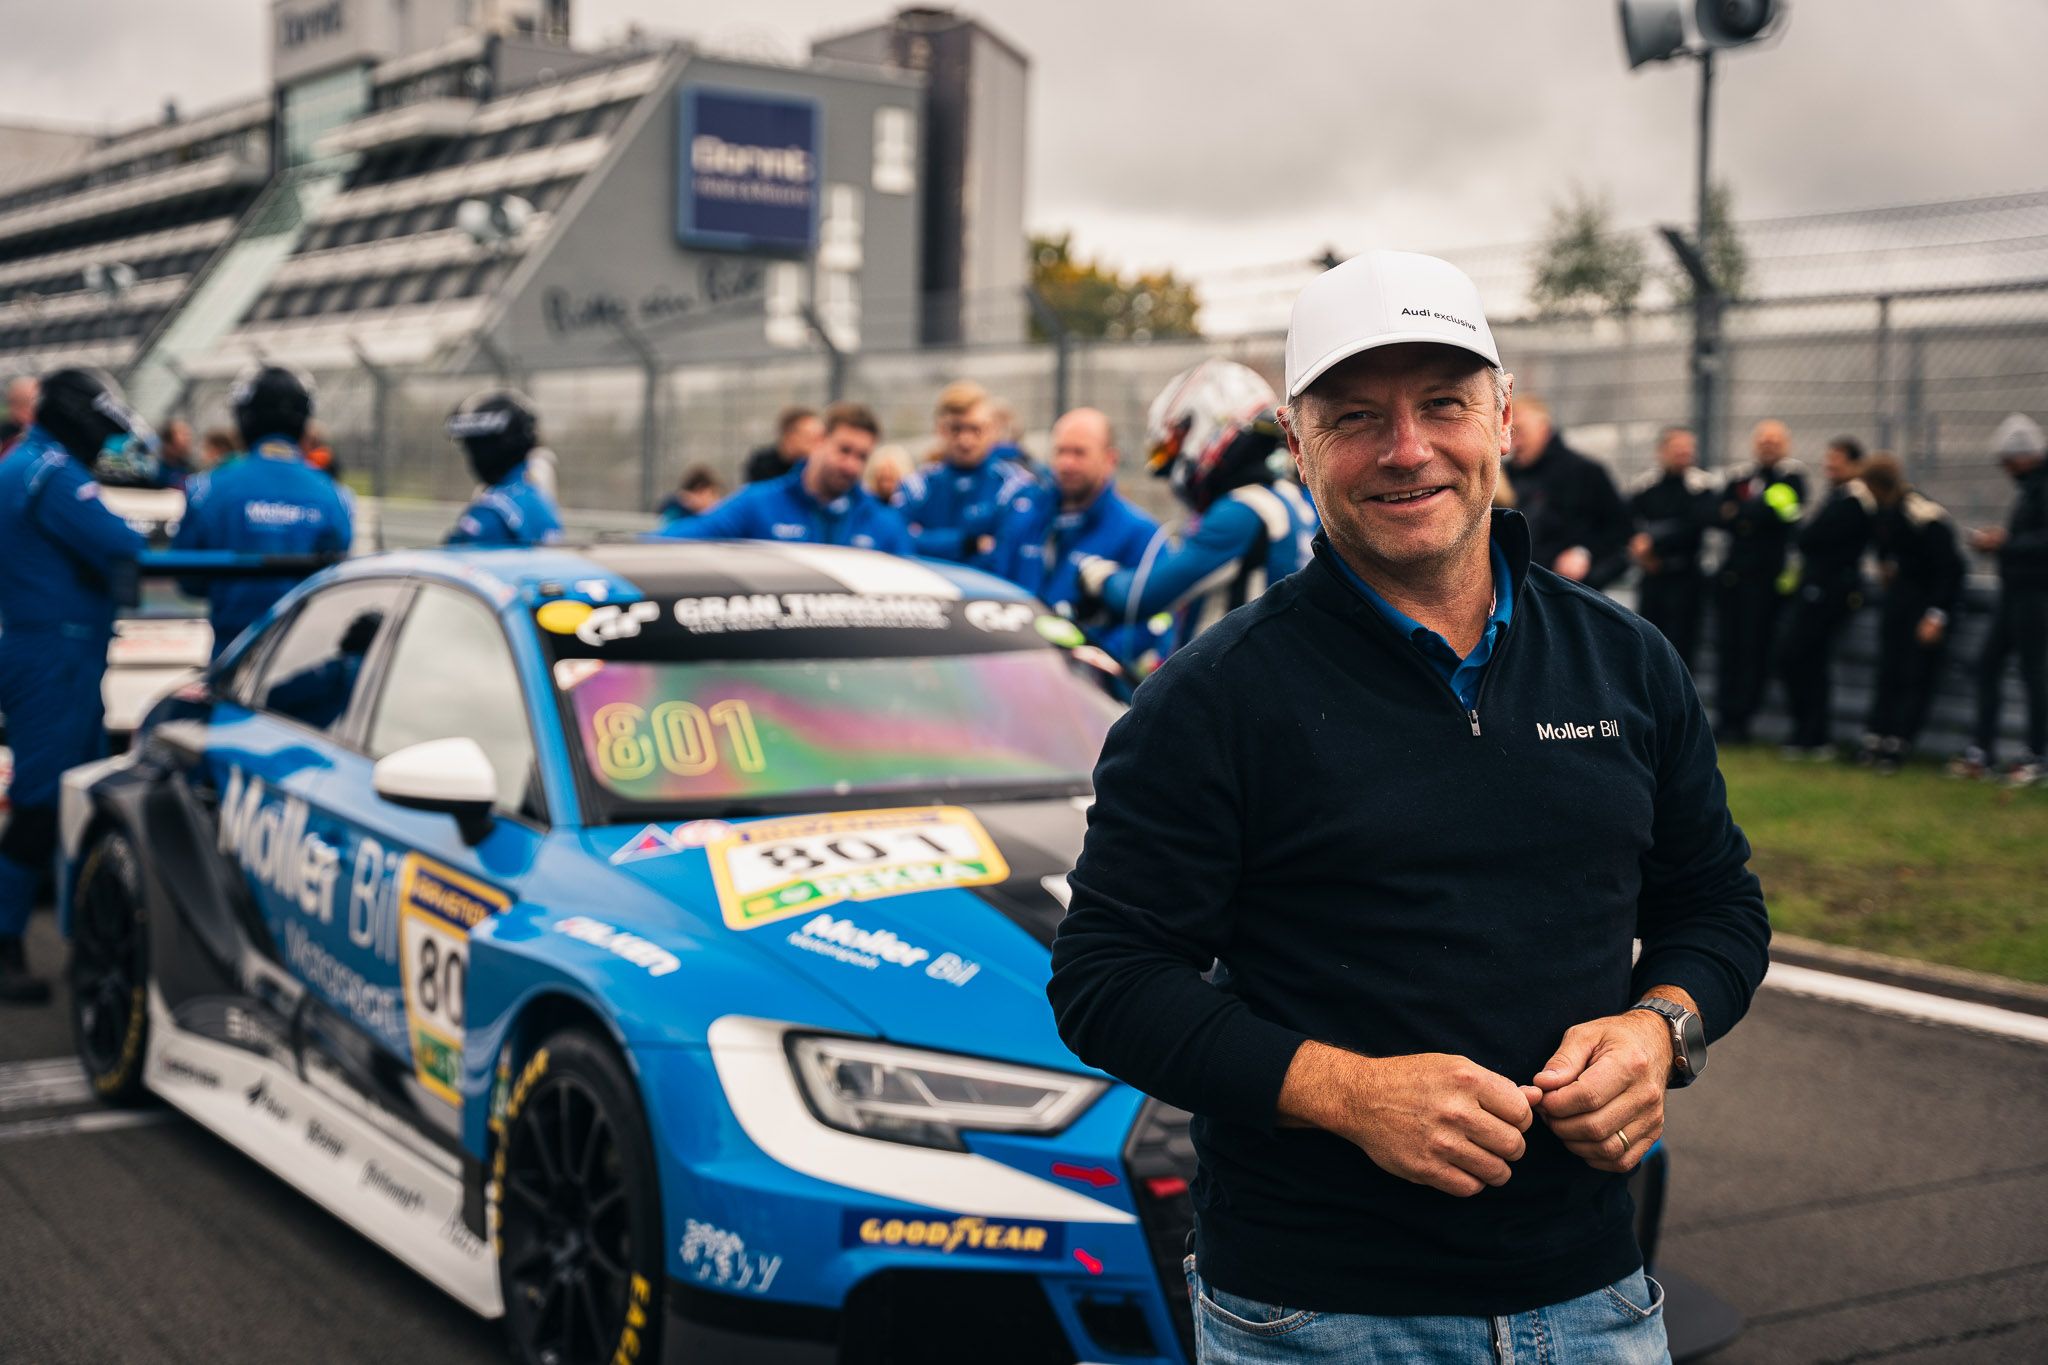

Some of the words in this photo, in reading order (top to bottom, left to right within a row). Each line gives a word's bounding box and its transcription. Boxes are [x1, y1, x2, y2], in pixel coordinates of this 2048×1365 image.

[1401, 307, 1431, 317] Audi
[1434, 312, 1477, 332] exclusive
[593, 699, 767, 780] 801
[1599, 719, 1620, 737] Bil
[760, 833, 949, 874] 801
[348, 837, 402, 966] Bil
[859, 1216, 1048, 1254] GOODYEAR
